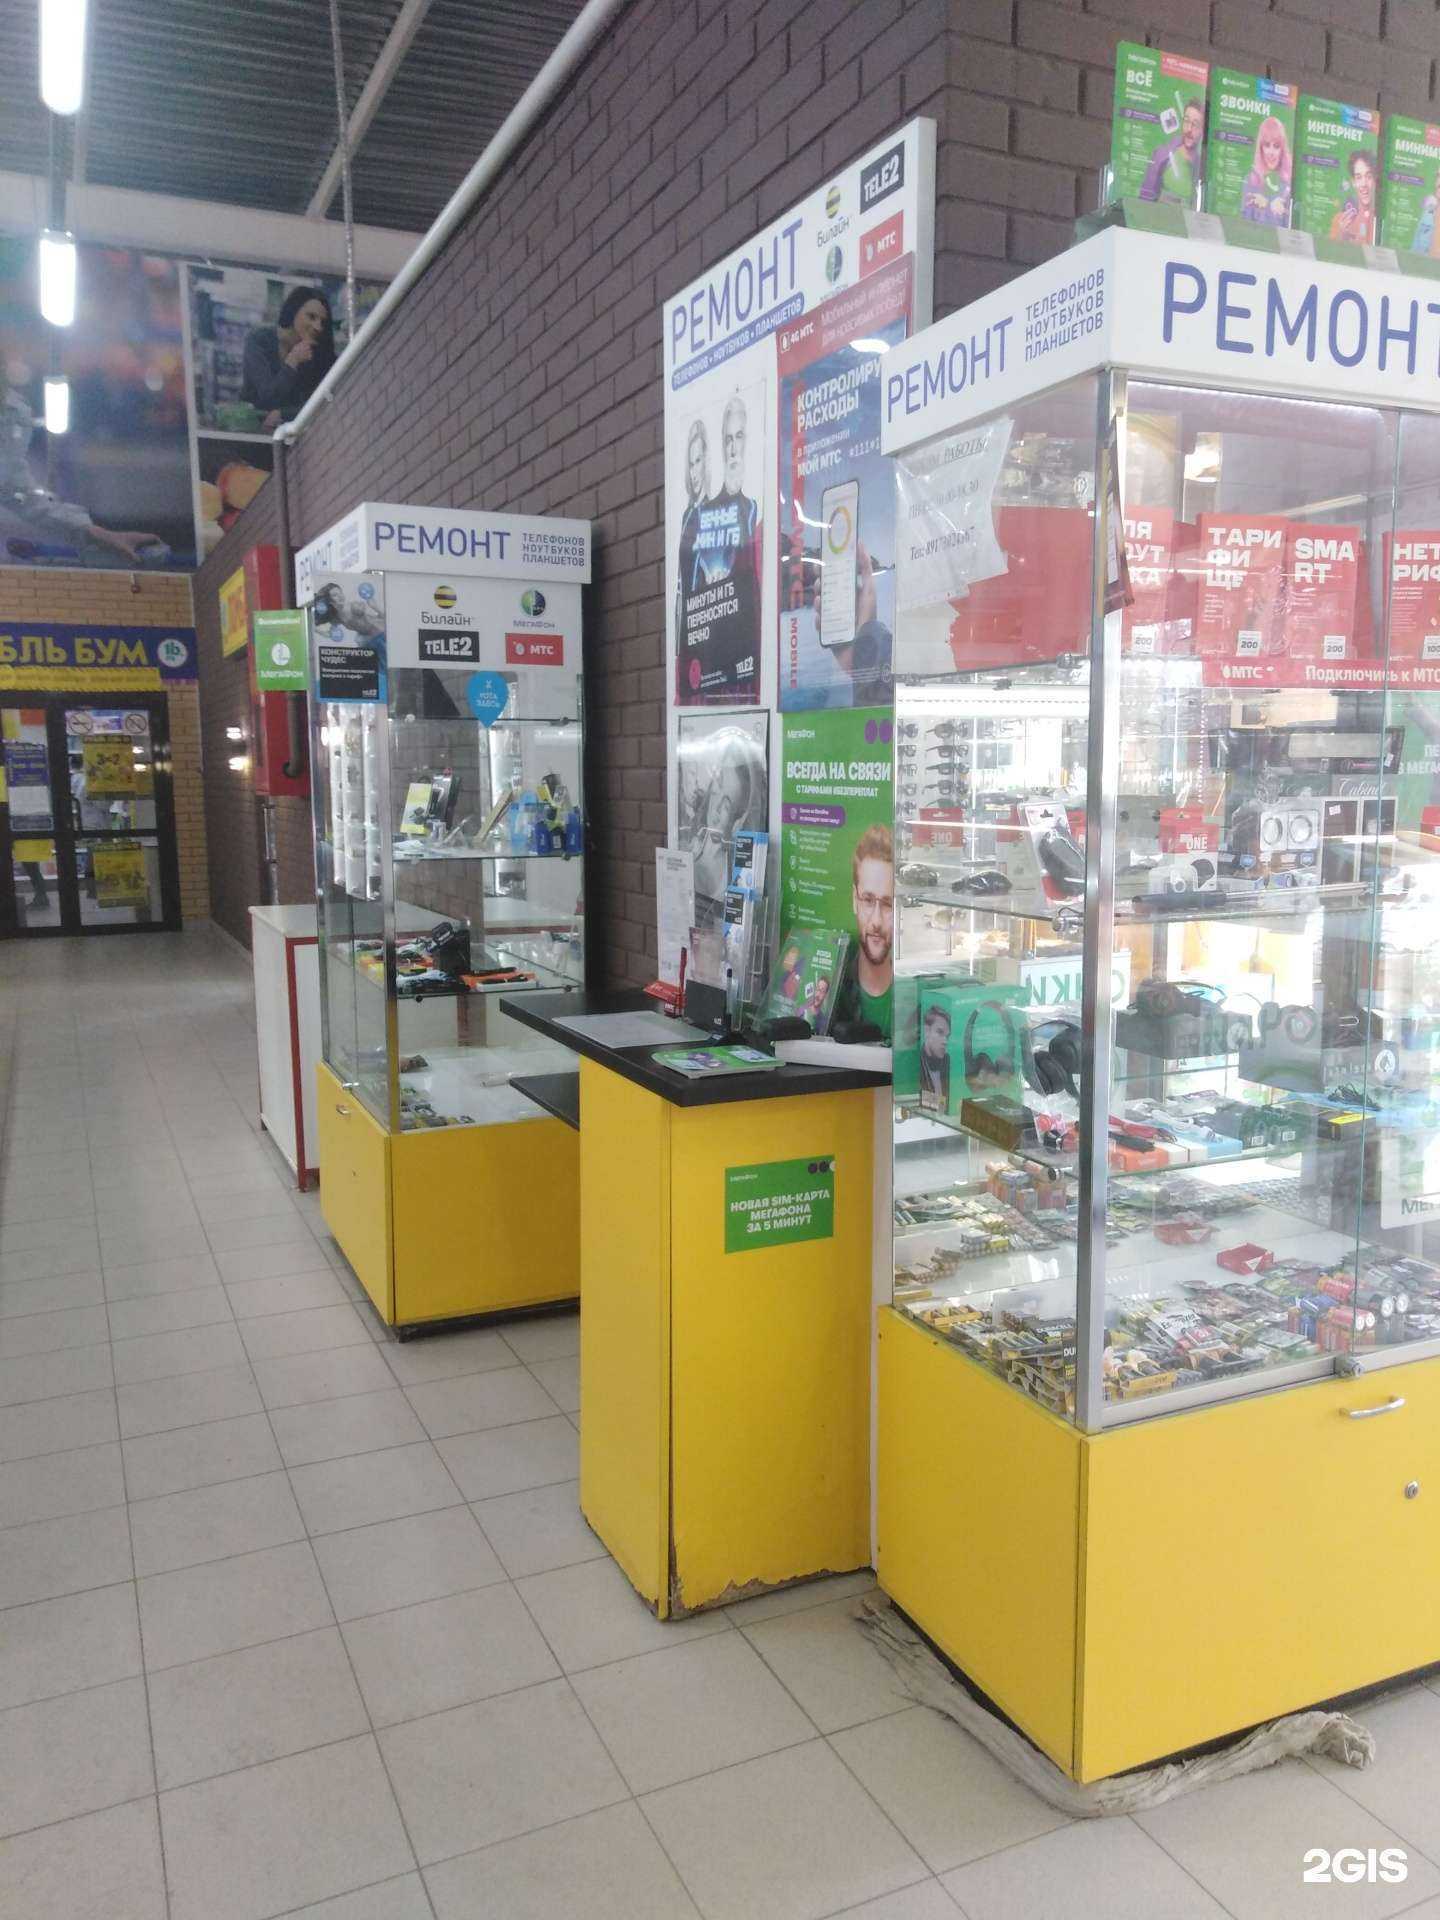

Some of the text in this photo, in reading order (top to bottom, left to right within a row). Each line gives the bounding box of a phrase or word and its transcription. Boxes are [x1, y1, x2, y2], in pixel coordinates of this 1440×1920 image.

[1126, 69, 1153, 87] ВСЁ
[1220, 94, 1271, 116] ЗВОНКИ
[1306, 119, 1364, 143] ИНТЕРНЕТ
[864, 154, 900, 202] TELE2
[817, 216, 849, 248] Билайн
[876, 231, 896, 253] МТС
[672, 218, 803, 365] РЕМОНТ
[1025, 267, 1105, 322] ТЕЛЕФОНОВ
[755, 298, 802, 337] ПЛАНШЕТОВ
[1025, 289, 1104, 343] НОУТБУКОВ
[1025, 311, 1104, 362] ПЛАНШЕТОВ
[887, 315, 1014, 423] РЕМОНТ
[797, 389, 860, 433] РАСХОДЫ
[797, 448, 842, 480] МОЙ МТС
[374, 521, 511, 561] РЕМОНТ
[522, 533, 585, 547] ТЕЛЕФОНОВ
[1207, 527, 1282, 549] ТАРИ
[522, 544, 585, 557] НОУТБУКОВ
[522, 554, 585, 567] ПЛАНШЕТОВ
[1206, 549, 1251, 570] ФИ
[1295, 537, 1355, 562] SMA
[1295, 562, 1332, 585] RT
[687, 582, 735, 613] МИНУТЫ И ГБ
[421, 611, 472, 626] Билайн
[687, 598, 739, 630] ПЕРЕНОСЯТСЯ
[424, 636, 473, 657] TELE2
[687, 626, 710, 646] ВЕЧНО
[1240, 640, 1259, 649] 200
[74, 637, 149, 665] БУМ
[530, 645, 554, 655] МТС
[1326, 644, 1344, 653] 200
[1231, 665, 1264, 679] МТС
[1305, 664, 1399, 683] Подключись
[1401, 670, 1410, 682] к
[786, 761, 892, 782] ВСЕГДА НА СВЯЗИ
[730, 1188, 830, 1213] НОВАЯ SIM-КАРТА
[746, 1214, 812, 1233] ЗА 5 МИНУТ
[750, 1203, 811, 1222] МЕГАФОНА
